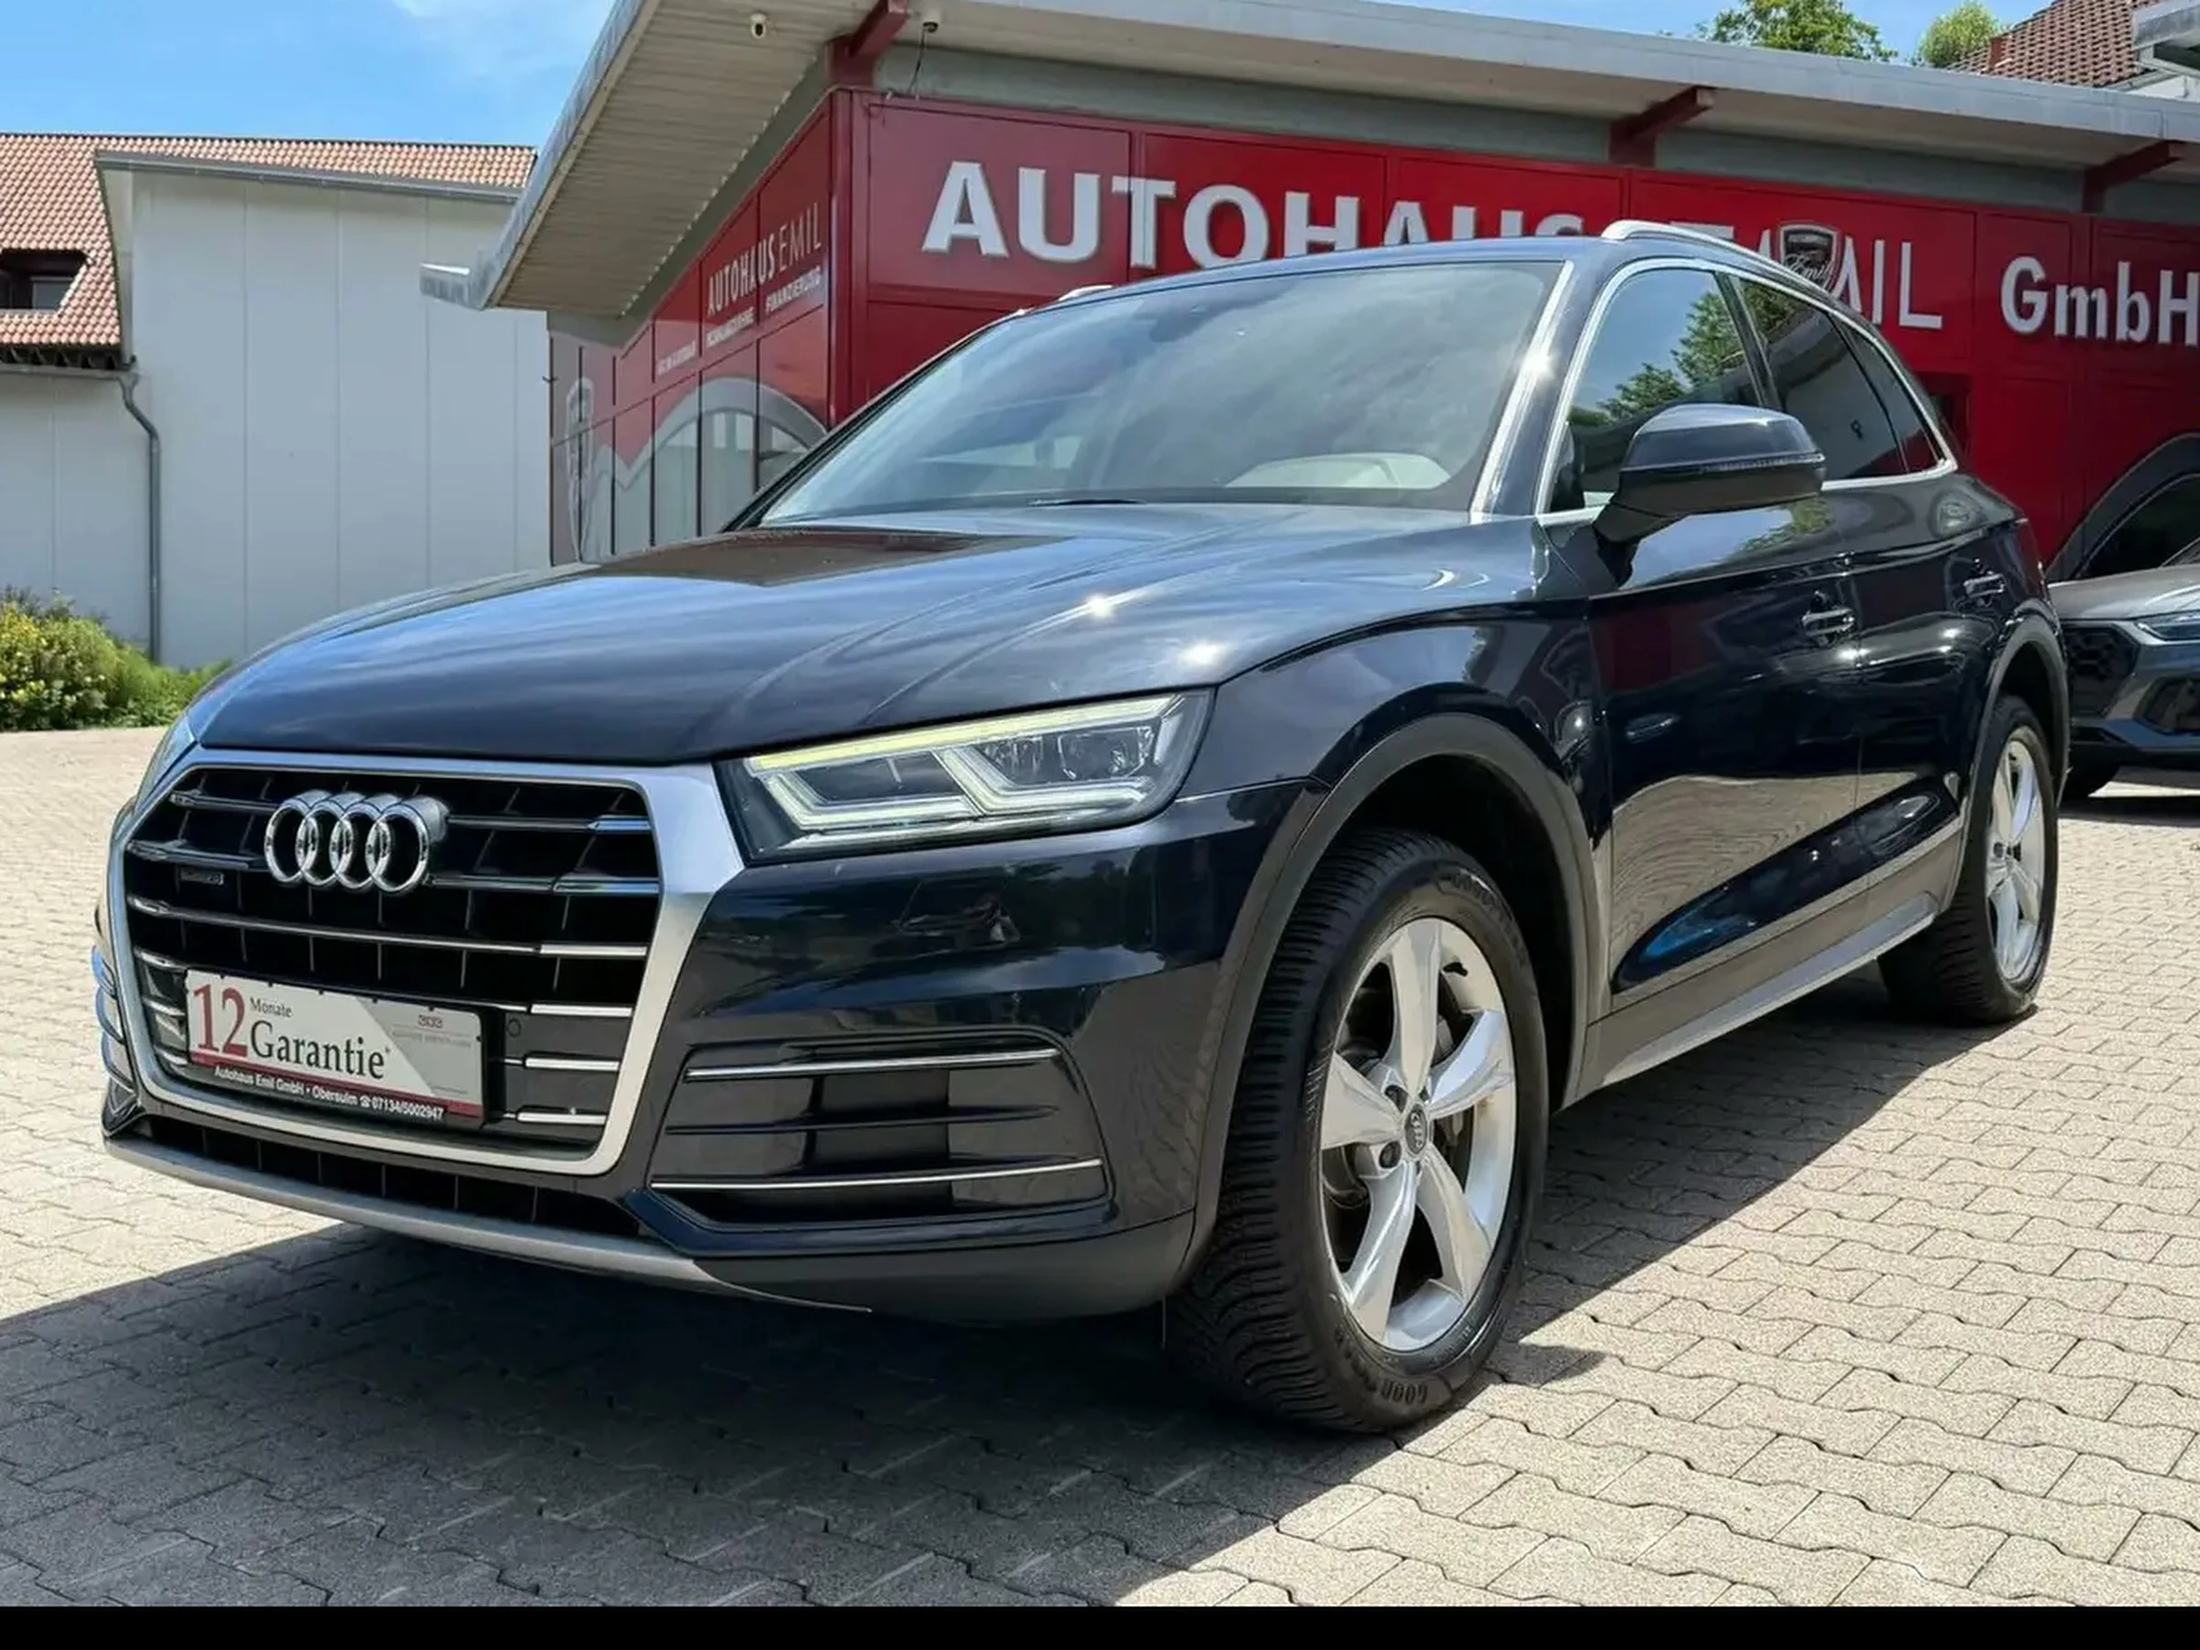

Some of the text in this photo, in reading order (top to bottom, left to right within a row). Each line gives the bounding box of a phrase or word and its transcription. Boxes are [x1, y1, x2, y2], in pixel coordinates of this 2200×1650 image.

[707, 202, 822, 318] AUTOHAUS EMIL
[921, 160, 2200, 348] AUTOHA MIL GmbH
[193, 983, 248, 1058] 12
[250, 997, 293, 1019] Monate
[214, 1066, 254, 1086] Autohaus
[255, 1074, 276, 1091] Emil
[276, 1078, 305, 1097] GmbH
[312, 1084, 358, 1106] Obersulm
